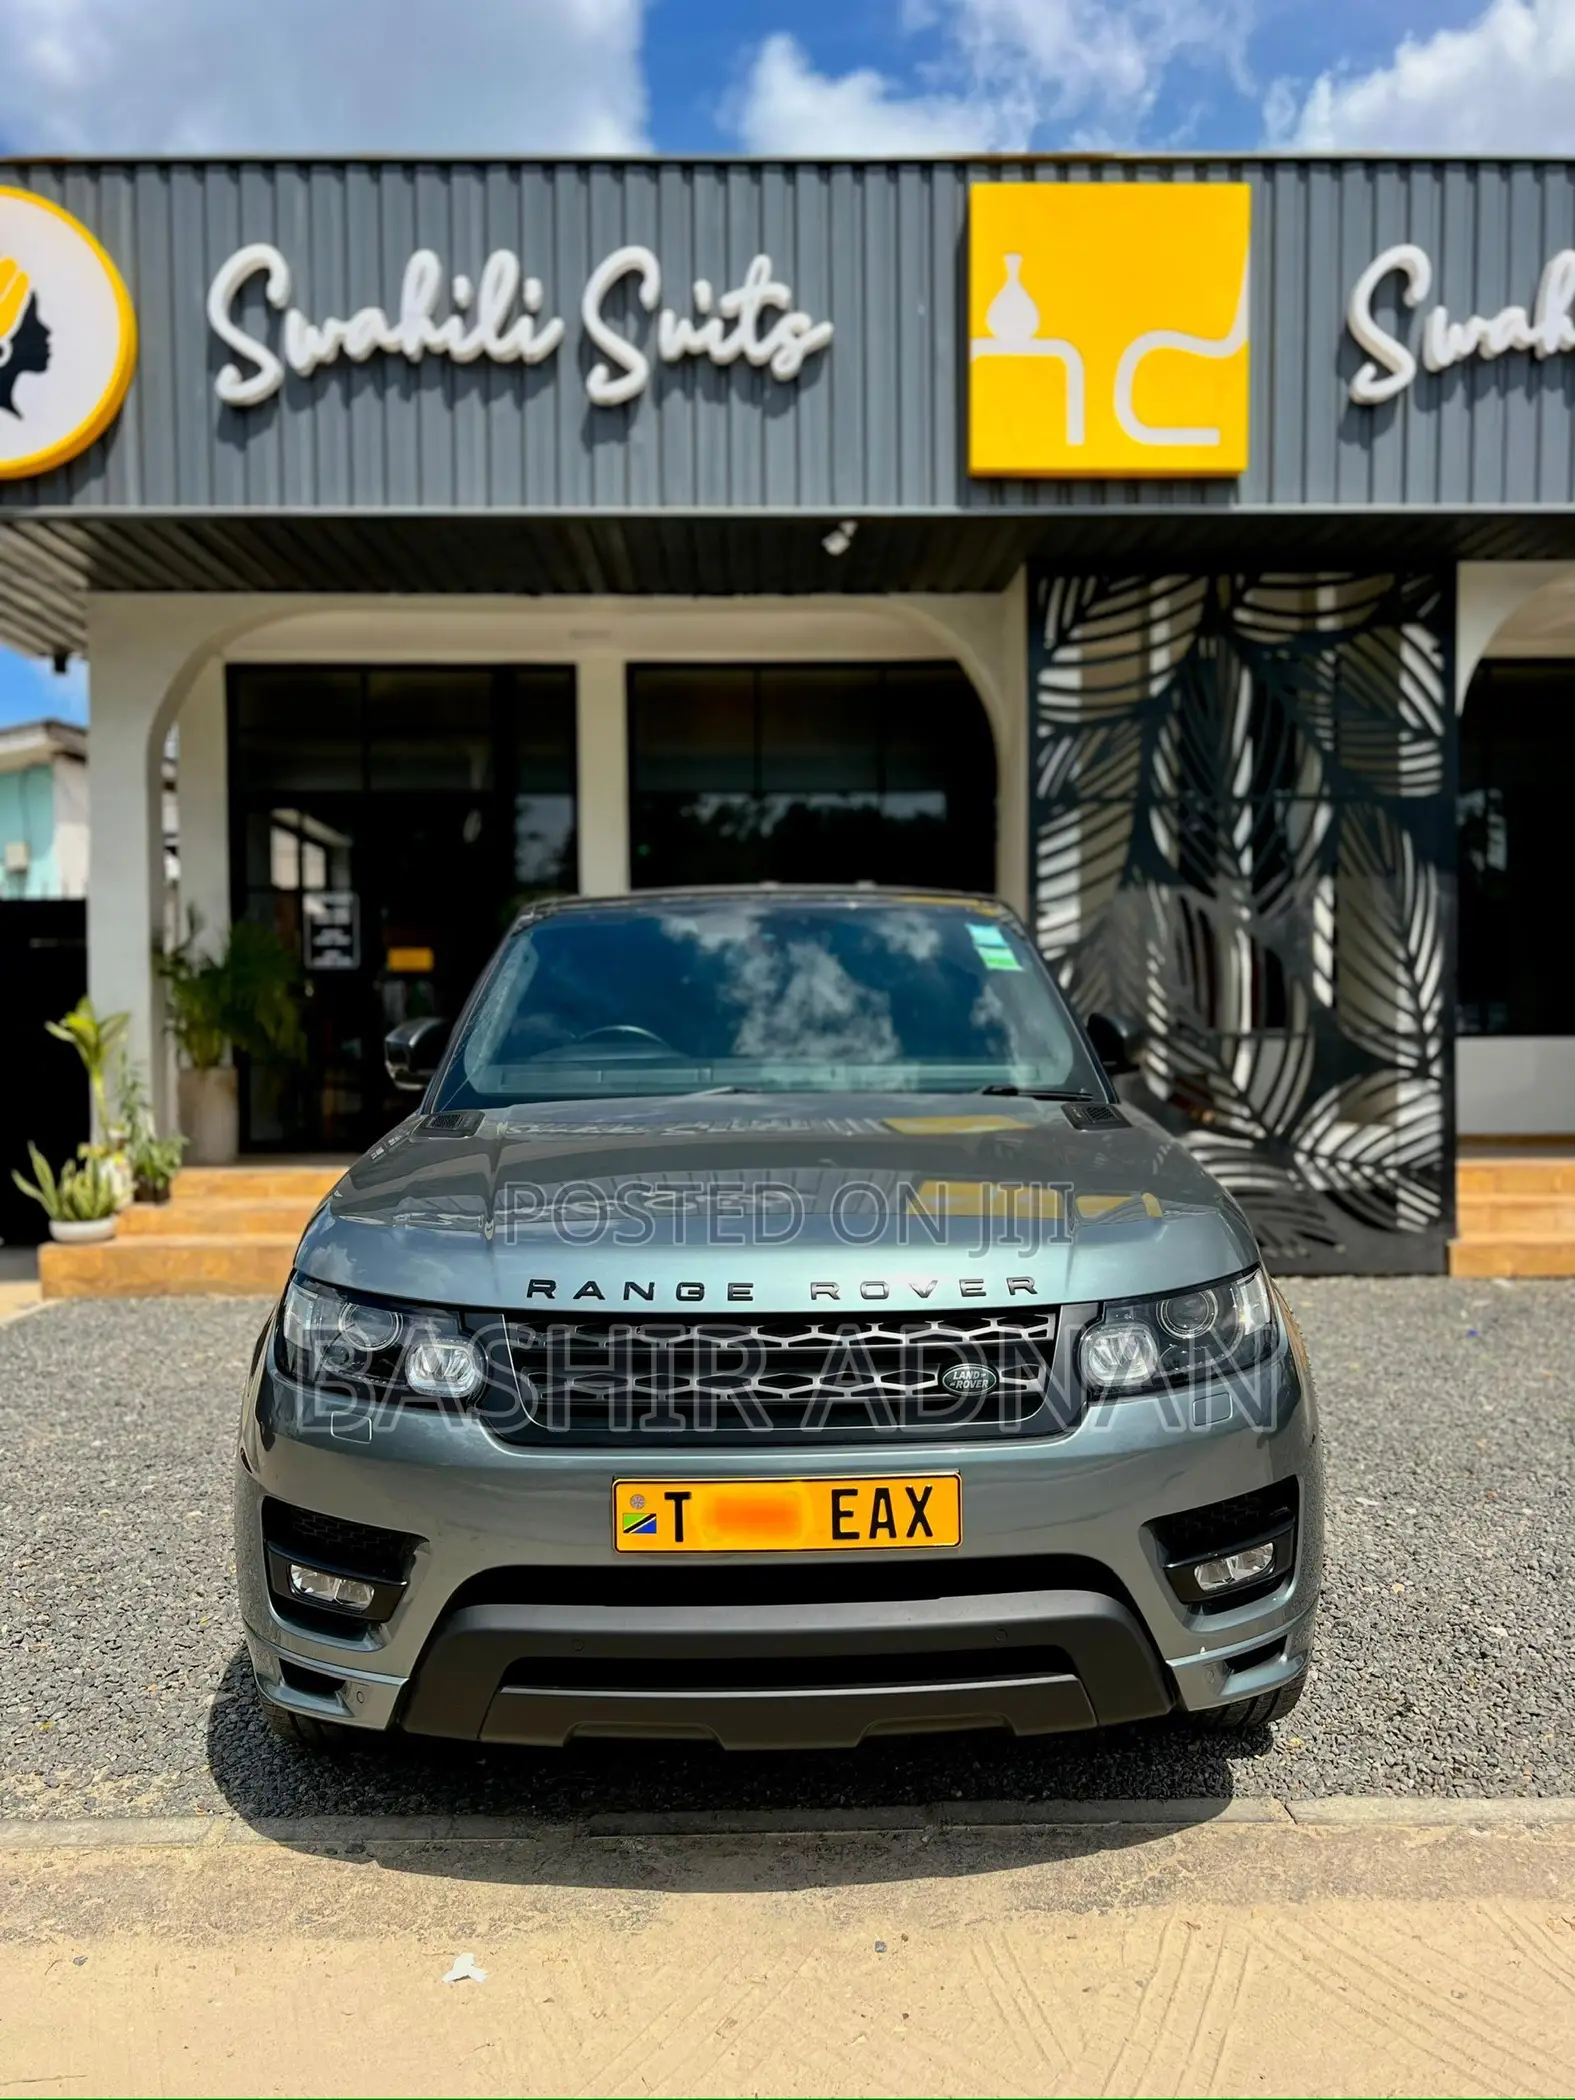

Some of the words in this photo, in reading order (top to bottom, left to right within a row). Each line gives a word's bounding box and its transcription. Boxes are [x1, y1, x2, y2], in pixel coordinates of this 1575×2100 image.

[208, 243, 563, 404] Swahili
[583, 245, 833, 404] Suits
[526, 1278, 755, 1302] RANGE
[810, 1276, 1038, 1300] ROVER
[953, 1370, 980, 1380] LAND
[955, 1379, 989, 1389] ROVER
[664, 1491, 692, 1543] T
[831, 1484, 934, 1540] EAX
